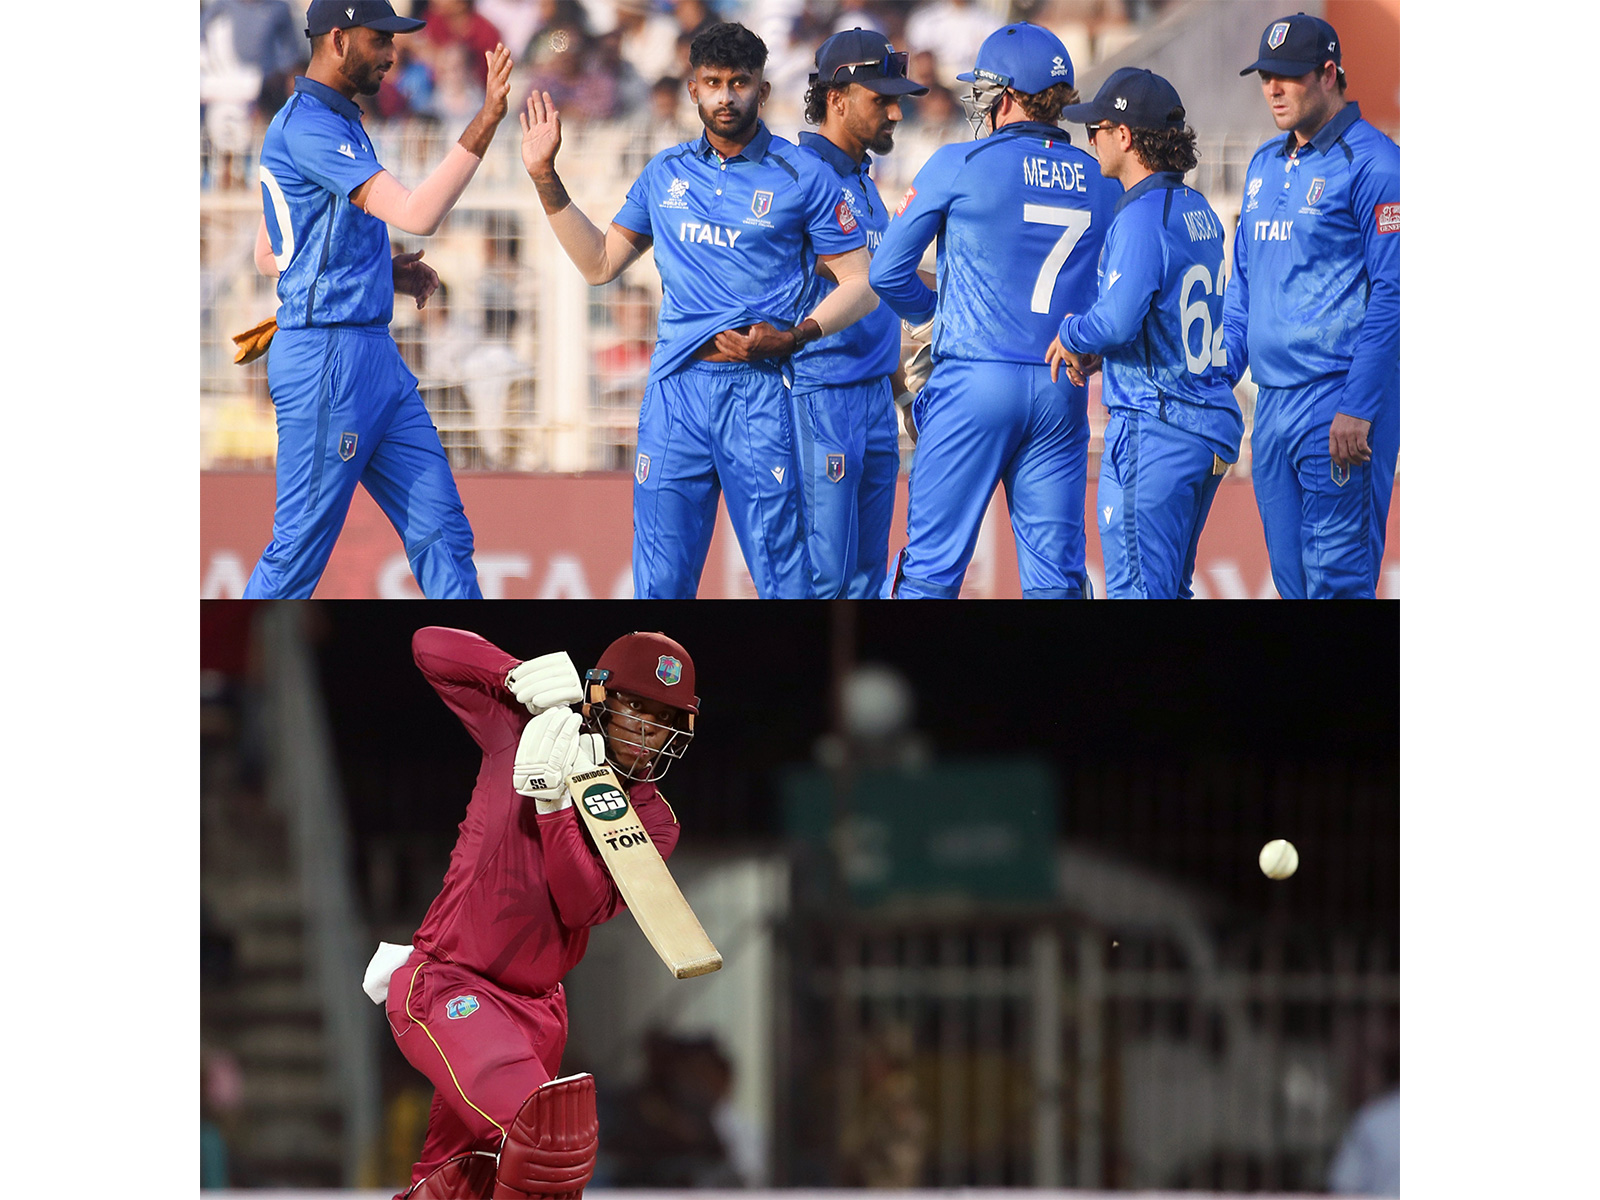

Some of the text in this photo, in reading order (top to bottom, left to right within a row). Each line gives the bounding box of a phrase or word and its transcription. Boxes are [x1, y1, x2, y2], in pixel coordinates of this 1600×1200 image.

[1327, 41, 1336, 53] 47
[1114, 97, 1128, 111] 30
[1023, 156, 1087, 193] MEADE
[679, 221, 742, 249] ITALY
[1254, 220, 1294, 241] ITALY
[1023, 203, 1091, 315] 7
[529, 777, 548, 790] SS
[571, 768, 610, 784] SUNRIDGES
[584, 790, 627, 815] SS
[606, 831, 648, 851] TON
